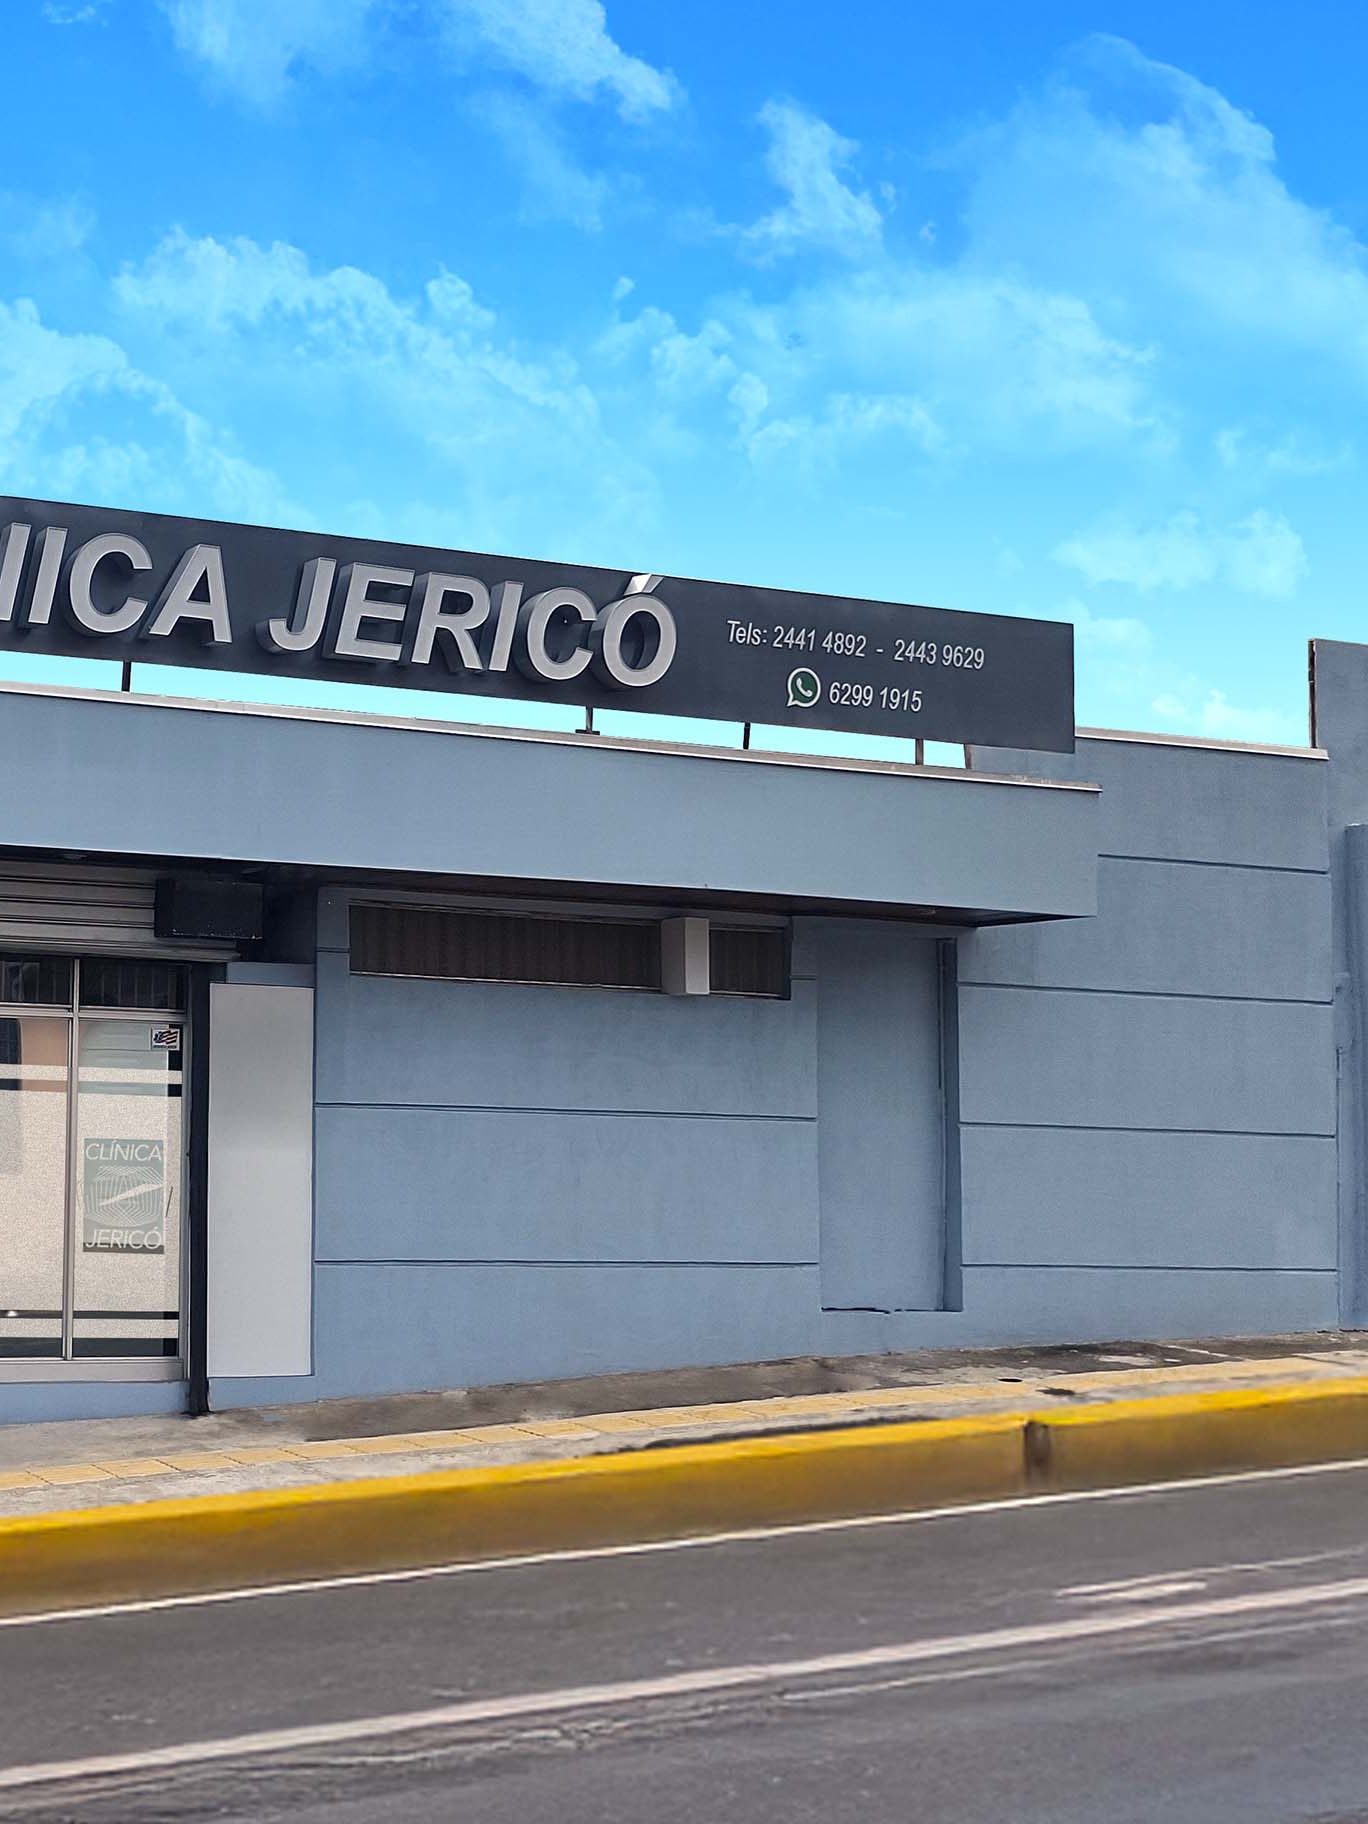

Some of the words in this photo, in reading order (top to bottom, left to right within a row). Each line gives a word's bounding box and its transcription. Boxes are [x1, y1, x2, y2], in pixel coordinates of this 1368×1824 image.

[262, 573, 677, 688] JERICÓ
[726, 620, 768, 645] Tels:
[772, 625, 816, 652] 2441
[822, 631, 867, 658] 4892
[894, 639, 937, 665] 2443
[942, 644, 985, 669] 9629
[829, 682, 874, 707] 6299
[879, 686, 923, 712] 1915
[84, 1140, 162, 1162] CLÍNICA
[84, 1226, 162, 1250] JERICÓ
